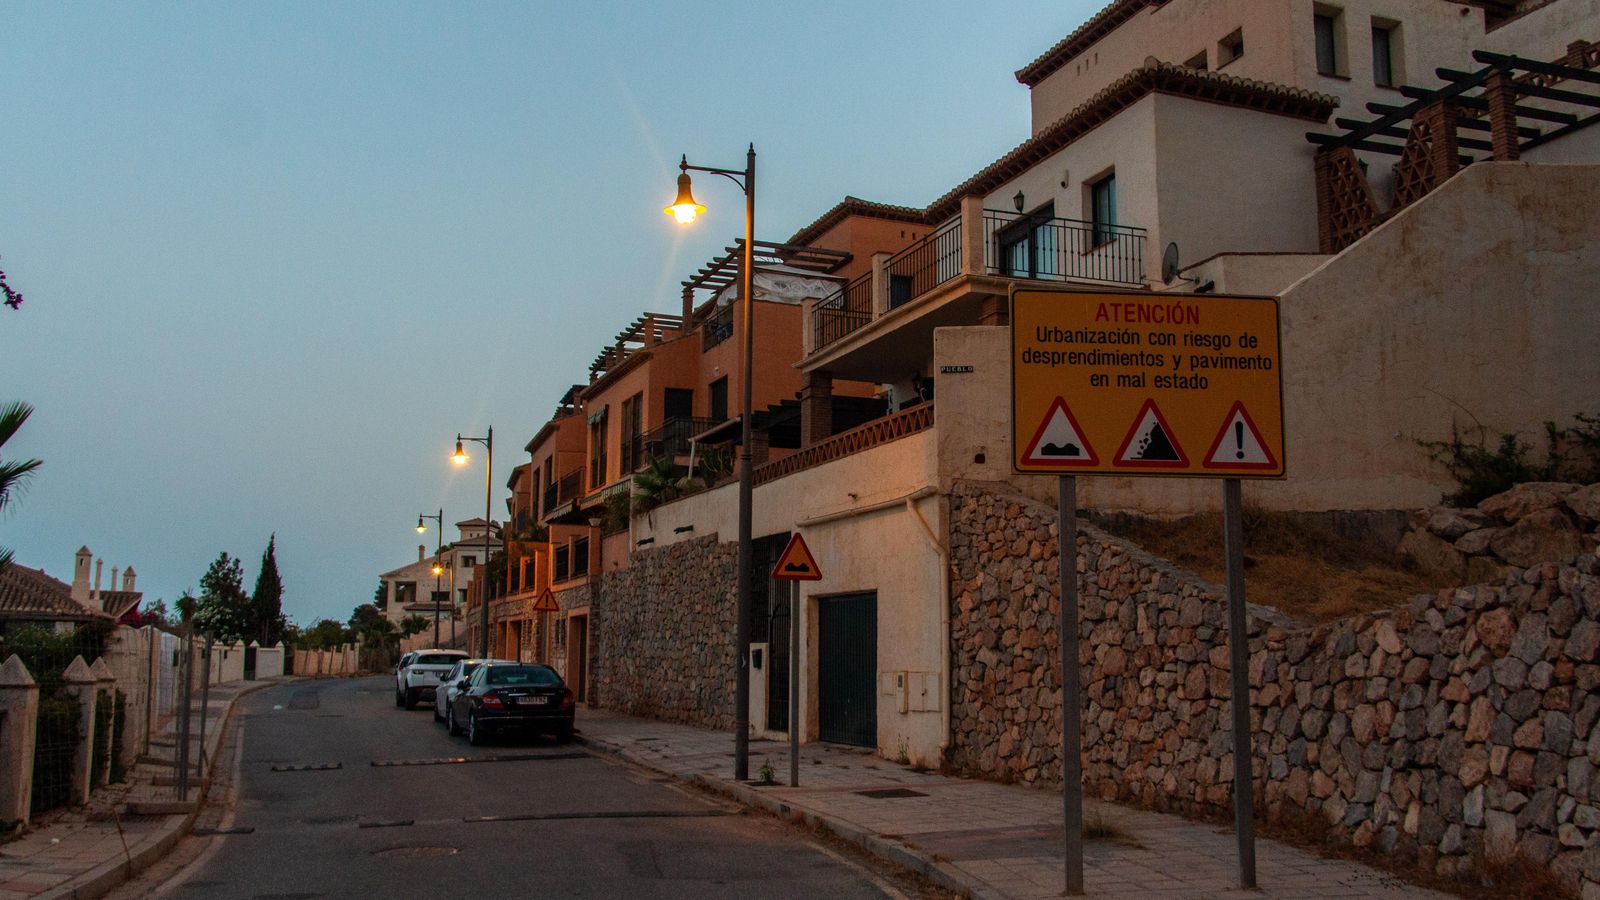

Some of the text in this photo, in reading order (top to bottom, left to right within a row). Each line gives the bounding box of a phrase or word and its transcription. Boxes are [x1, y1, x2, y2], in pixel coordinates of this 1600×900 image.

[1096, 301, 1200, 325] ATENCIÓN
[1037, 326, 1258, 351] Urbanización con riesgo de
[1022, 347, 1272, 371] desprendimientos y pavimento
[1090, 372, 1208, 390] en mal estado
